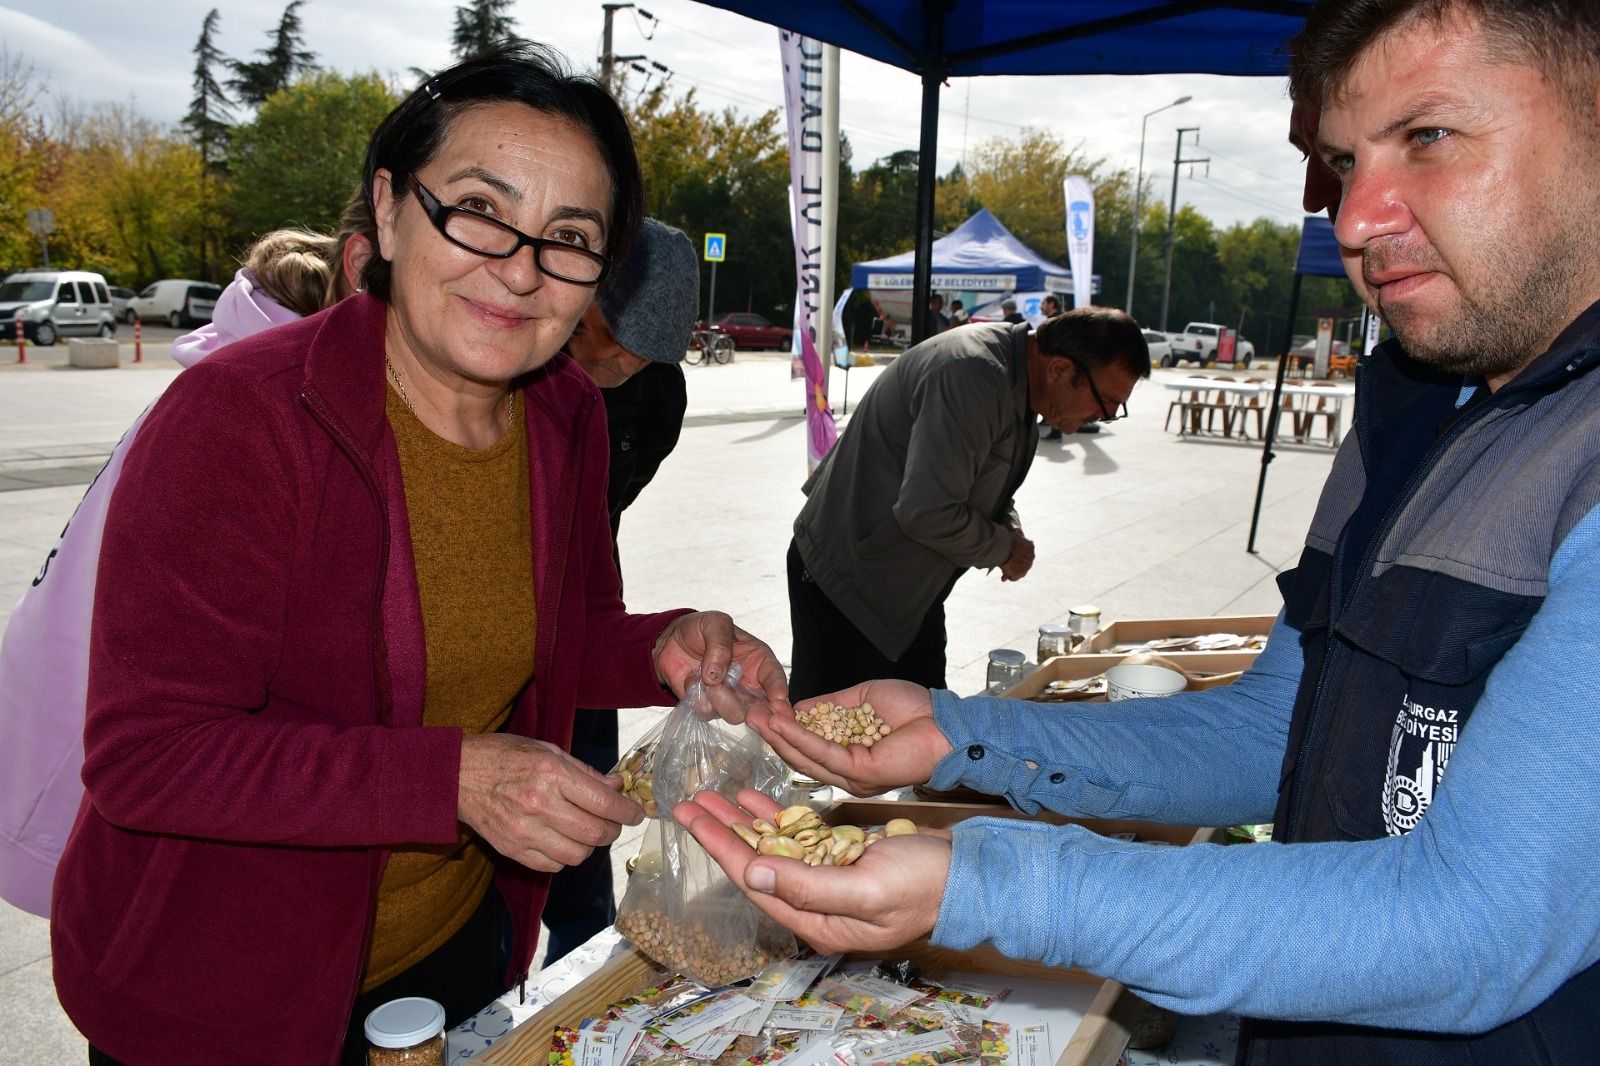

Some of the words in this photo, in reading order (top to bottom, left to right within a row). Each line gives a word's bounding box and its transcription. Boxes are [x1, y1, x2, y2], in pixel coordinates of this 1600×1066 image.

[885, 276, 942, 286] LÜLEBAZ
[944, 277, 998, 287] BELEDİYESİ
[1403, 693, 1458, 723] LURGAZ
